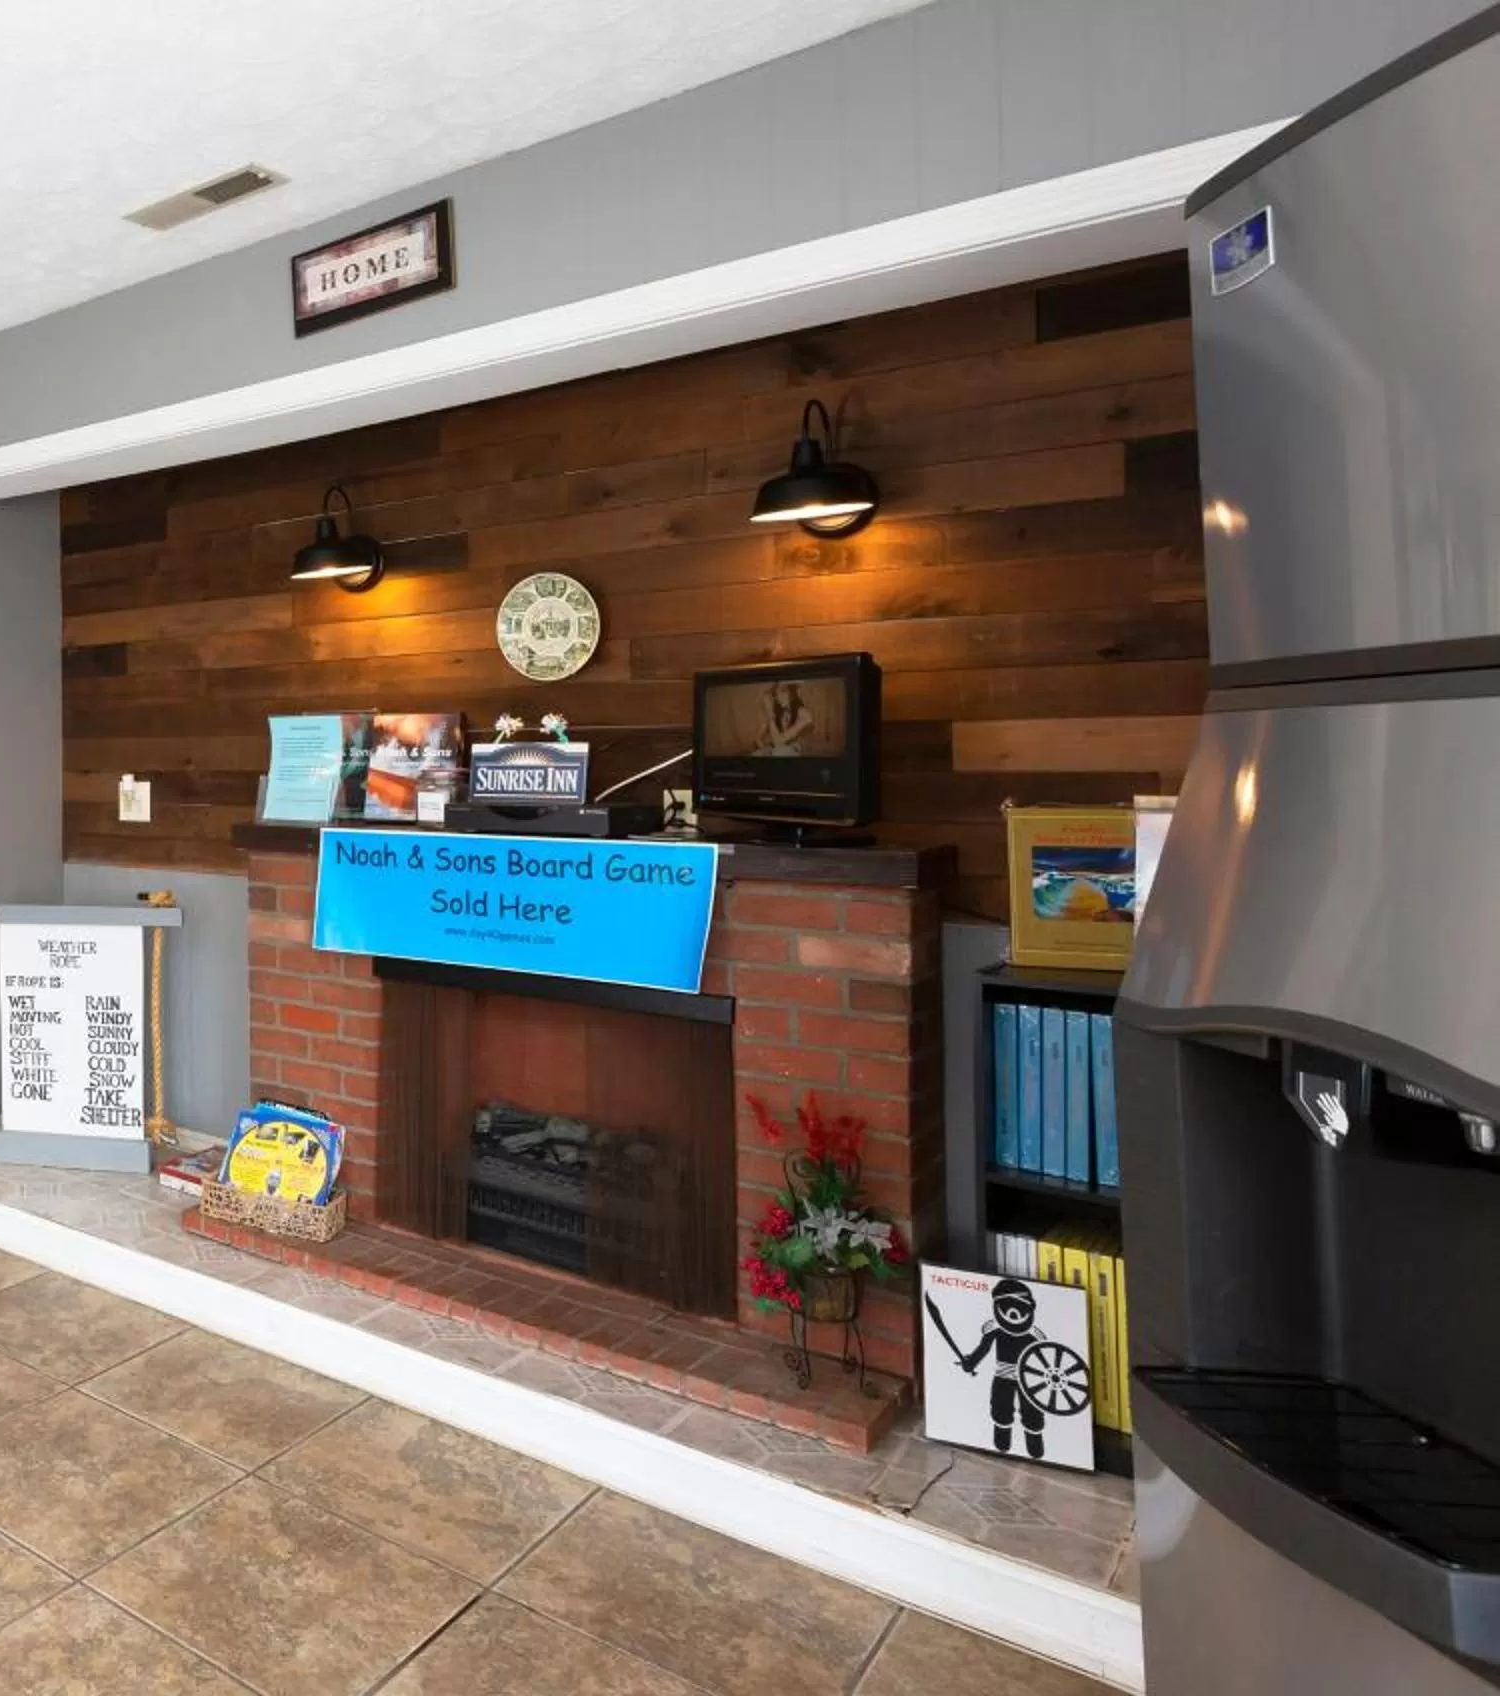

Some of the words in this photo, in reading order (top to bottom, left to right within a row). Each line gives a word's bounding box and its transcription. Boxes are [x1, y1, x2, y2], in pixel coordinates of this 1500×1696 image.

[320, 247, 409, 291] HOME
[476, 767, 544, 792] SUNRISE
[546, 767, 579, 793] INN
[336, 840, 398, 868] Noah
[407, 844, 425, 870] &
[435, 848, 497, 875] Sons
[507, 850, 593, 880] Board
[605, 854, 696, 886] Game
[430, 889, 489, 917] Sold
[499, 892, 573, 924] Here
[37, 939, 98, 955] WEATHER
[7, 995, 35, 1010] WET
[85, 995, 121, 1011] RAIN
[9, 1011, 62, 1024] MOVING
[85, 1011, 133, 1025] WINDY
[9, 1023, 35, 1037] HOT
[87, 1025, 133, 1041] SUNNY
[9, 1037, 45, 1051] COOL
[87, 1040, 139, 1057] CLOUDY
[87, 1055, 127, 1073] COLD
[11, 1066, 58, 1083] WHITE
[89, 1071, 136, 1089] SNOW
[11, 1082, 53, 1102] GONE
[84, 1087, 127, 1109] TAKE
[80, 1105, 142, 1128] SHELTER
[931, 1273, 989, 1292] TACTICUS
